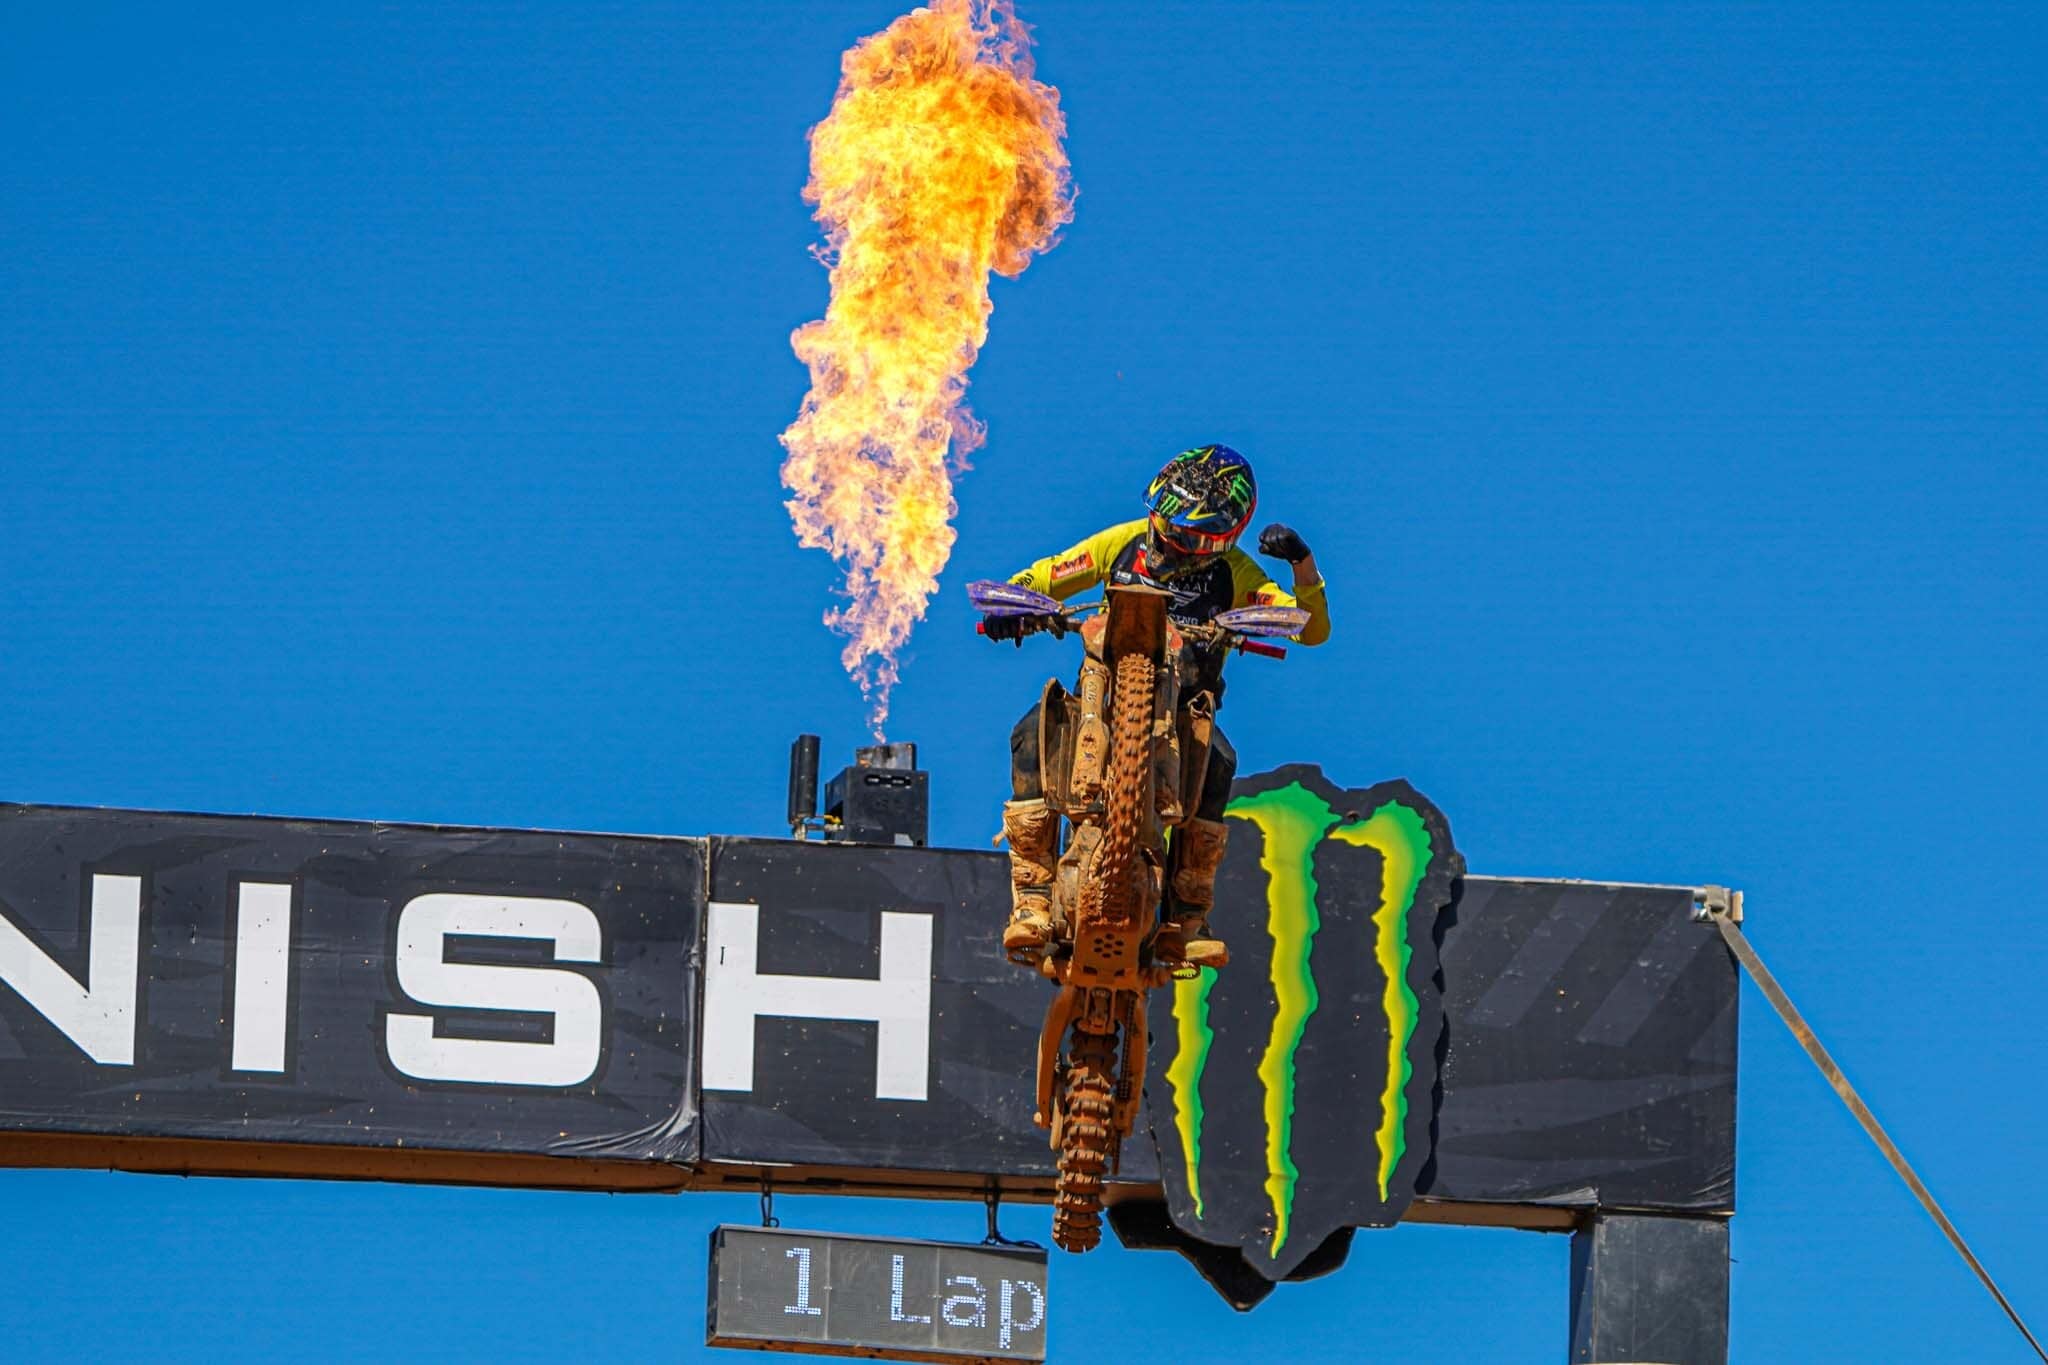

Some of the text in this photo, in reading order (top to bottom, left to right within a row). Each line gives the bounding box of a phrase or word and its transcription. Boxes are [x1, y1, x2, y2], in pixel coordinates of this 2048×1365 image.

[0, 873, 933, 1101] NISH
[784, 1247, 1045, 1350] 1 Lap
